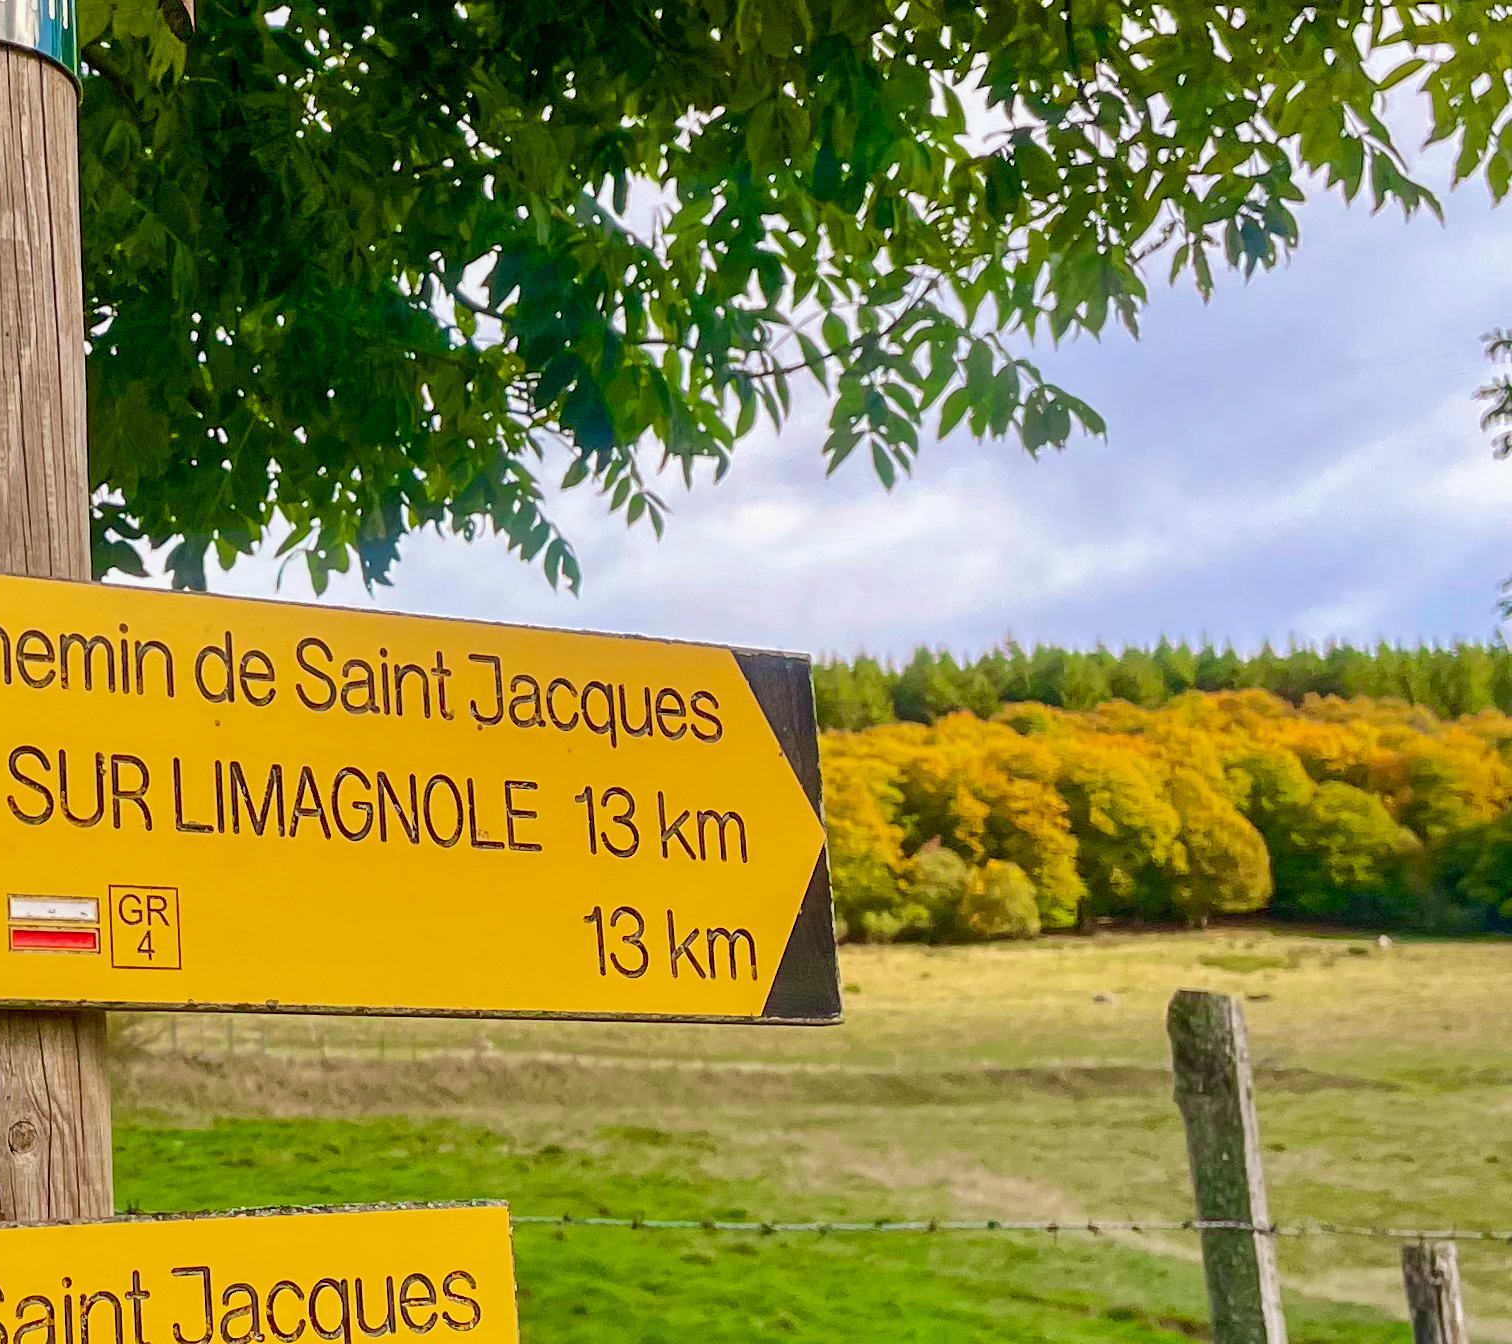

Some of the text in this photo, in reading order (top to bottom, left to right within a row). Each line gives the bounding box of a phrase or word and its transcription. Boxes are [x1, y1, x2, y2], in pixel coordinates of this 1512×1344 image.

[195, 631, 276, 706] de
[296, 638, 454, 720] Saint
[469, 654, 722, 748] Jacques
[7, 746, 152, 831] SUR
[173, 757, 542, 851] LIMAGNOLE
[575, 786, 639, 858] 13
[658, 791, 747, 863] km
[118, 893, 169, 927] GR
[136, 931, 156, 961] 4
[584, 906, 757, 980] 13 km
